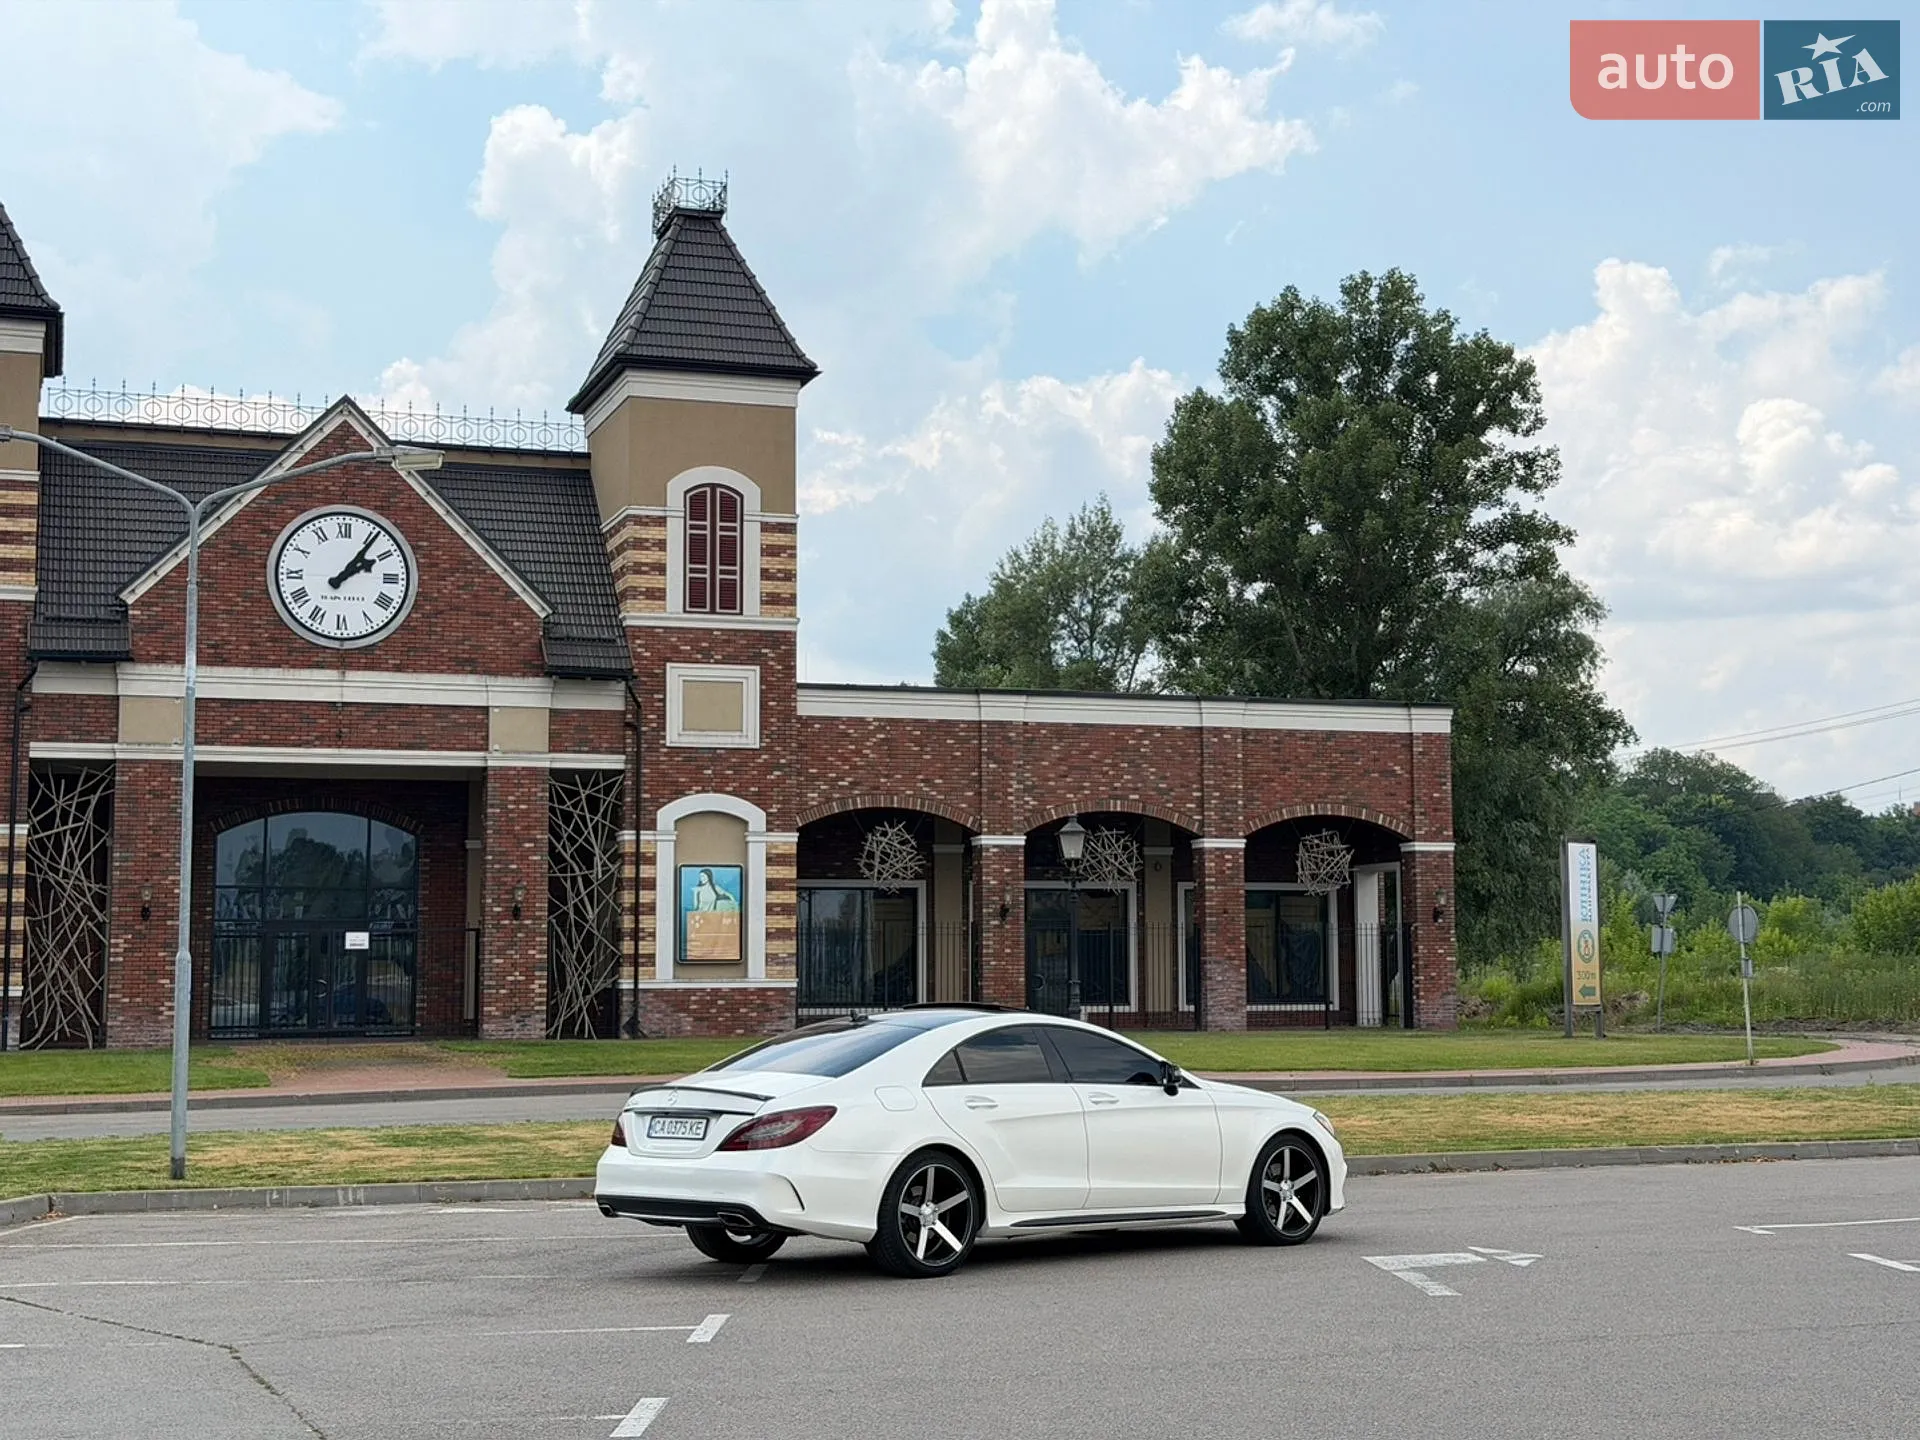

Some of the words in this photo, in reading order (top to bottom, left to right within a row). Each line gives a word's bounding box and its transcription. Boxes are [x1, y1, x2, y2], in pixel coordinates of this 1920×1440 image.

[312, 526, 329, 544] XI
[336, 522, 352, 539] XII
[293, 545, 311, 559] X
[376, 549, 394, 562] II
[286, 568, 303, 580] IX
[383, 573, 399, 584] III
[336, 614, 348, 631] VI
[361, 610, 373, 626] V
[654, 1119, 666, 1134] CA
[667, 1120, 688, 1135] 0375
[688, 1121, 703, 1136] KE
